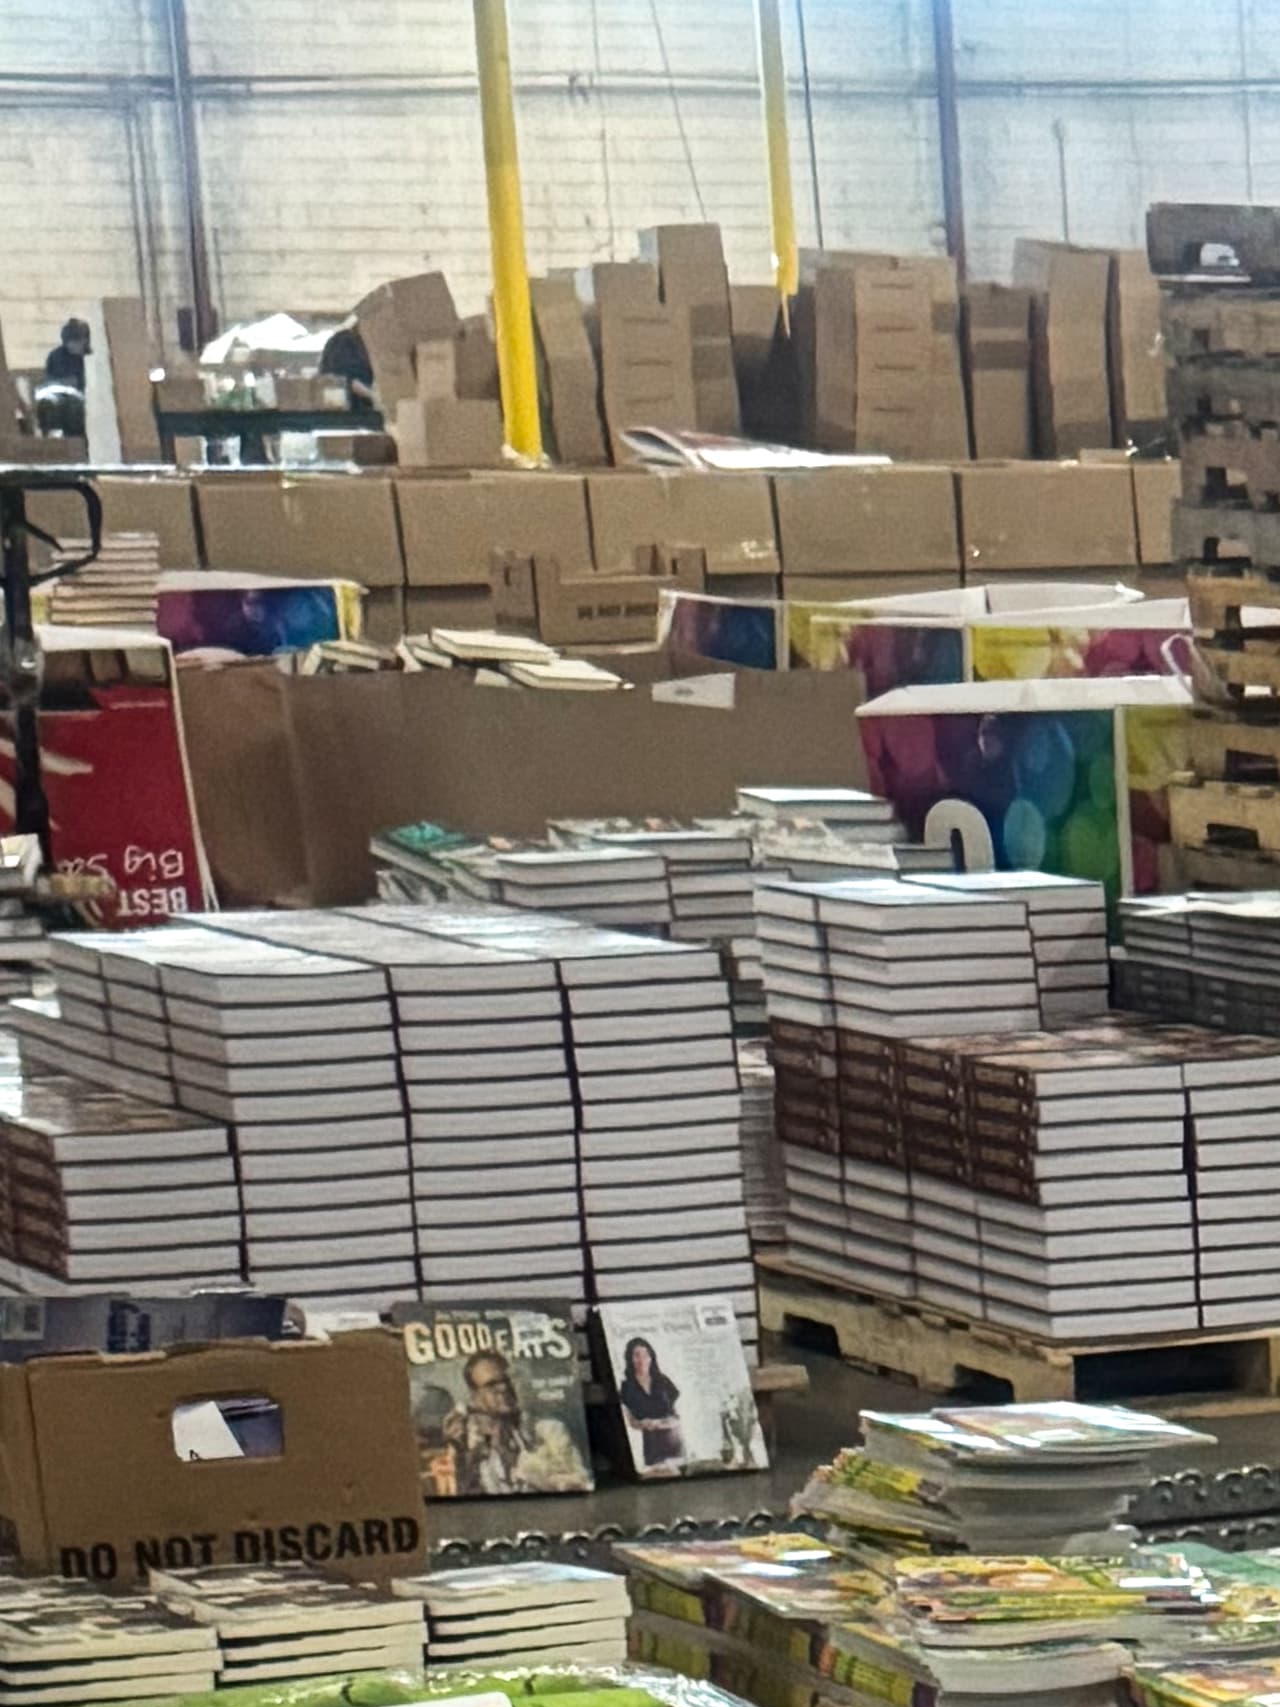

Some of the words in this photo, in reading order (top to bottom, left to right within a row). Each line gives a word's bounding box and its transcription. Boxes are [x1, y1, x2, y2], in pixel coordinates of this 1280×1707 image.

[116, 886, 188, 915] BEST
[404, 1321, 493, 1365] GOOD
[60, 1543, 117, 1580] DO
[135, 1532, 217, 1577] NOT
[232, 1517, 420, 1566] DISCARD
